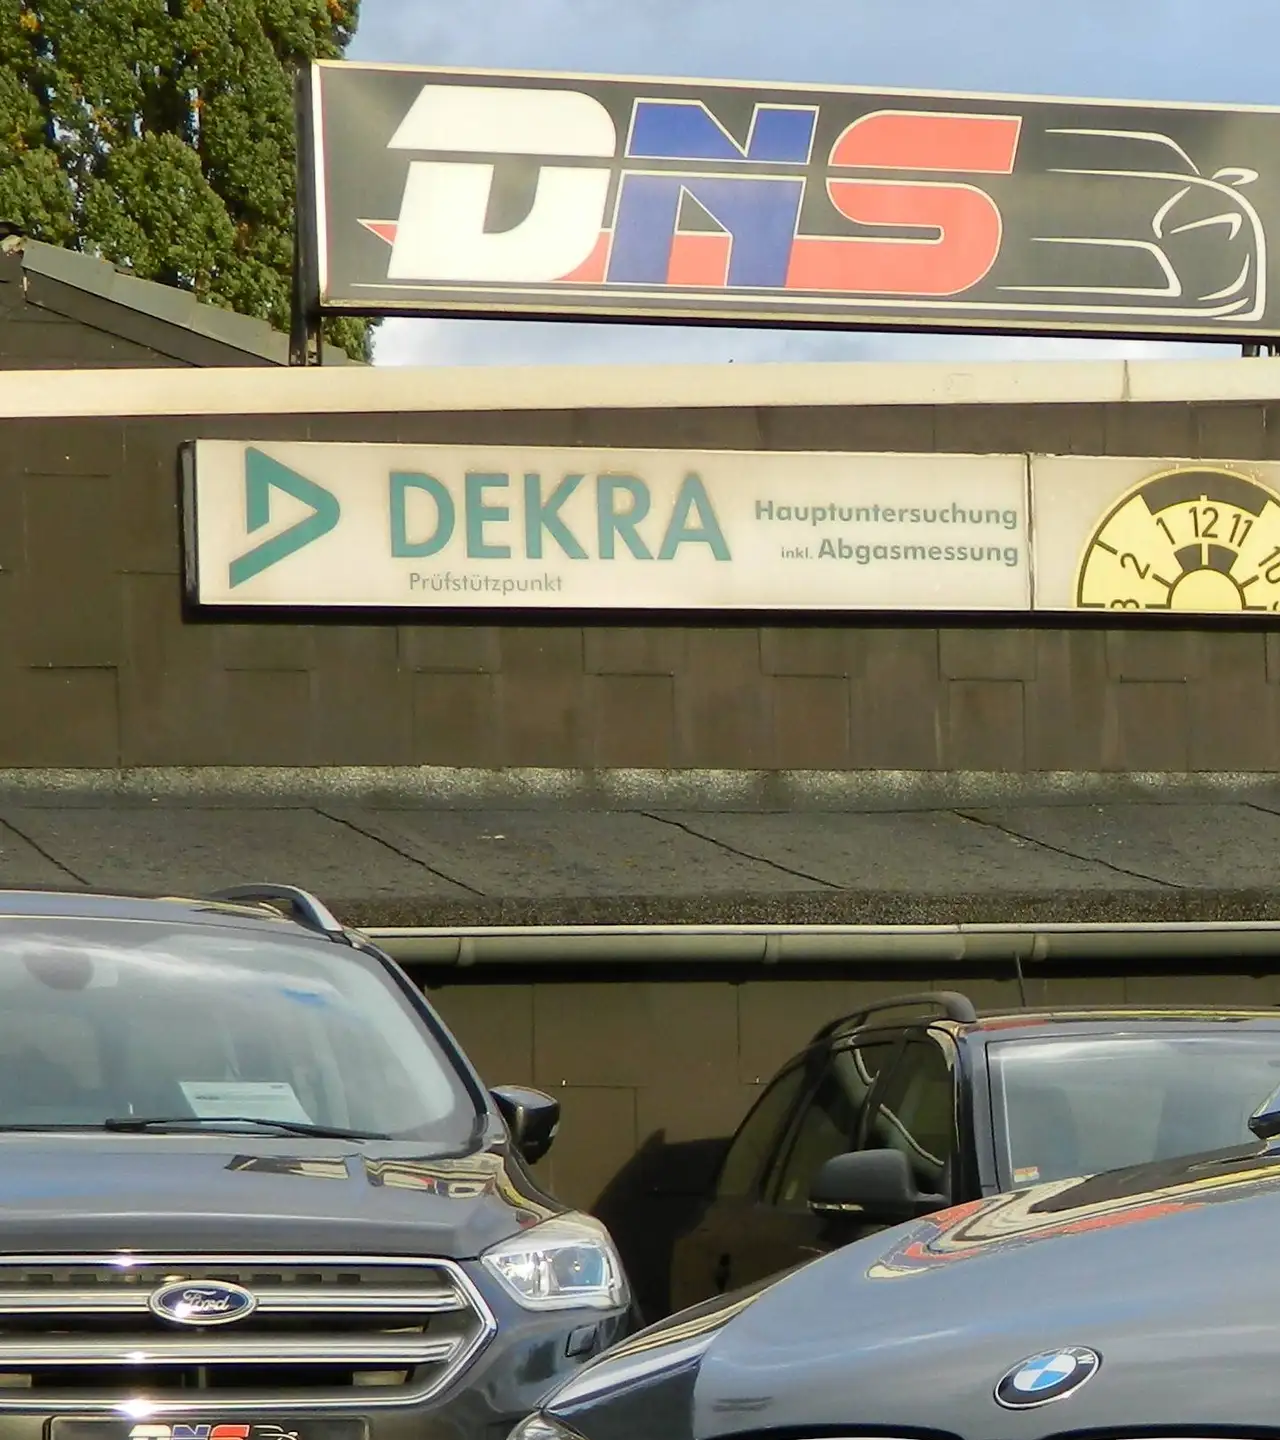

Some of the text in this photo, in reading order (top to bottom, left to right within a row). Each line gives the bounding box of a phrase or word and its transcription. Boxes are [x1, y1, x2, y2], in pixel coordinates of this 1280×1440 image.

[386, 84, 1022, 296] DNS
[388, 469, 733, 562] DEKRA
[754, 499, 1018, 530] Hauptuntersuchung
[781, 537, 1019, 567] inkl. Abgasmessung
[1120, 552, 1151, 580] 2
[1154, 516, 1177, 546] 1
[1188, 506, 1219, 539] 12
[1227, 513, 1254, 548] 11
[409, 570, 563, 597] Prüfstützpunkt
[180, 1288, 232, 1313] Ford
